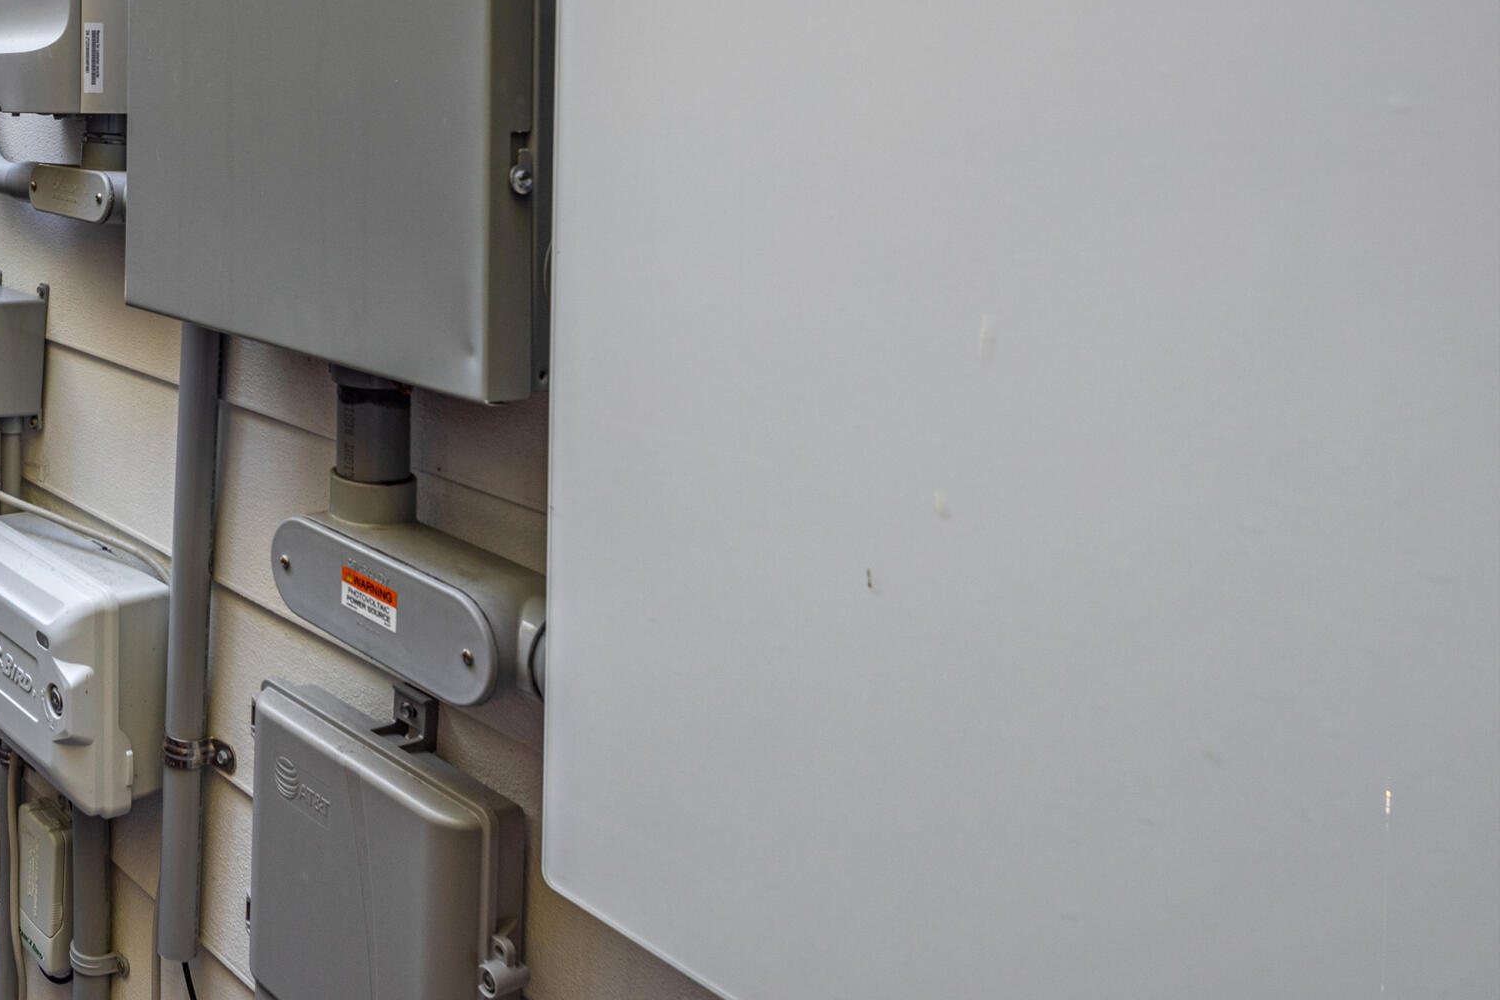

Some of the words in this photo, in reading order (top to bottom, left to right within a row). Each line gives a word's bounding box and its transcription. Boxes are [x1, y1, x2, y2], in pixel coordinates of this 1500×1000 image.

[347, 586, 390, 614] PHOTOVOLTAIC
[353, 575, 392, 603] WARNING
[346, 594, 366, 609] POWER
[367, 604, 390, 624] SOURCE
[300, 784, 331, 817] AT&T
